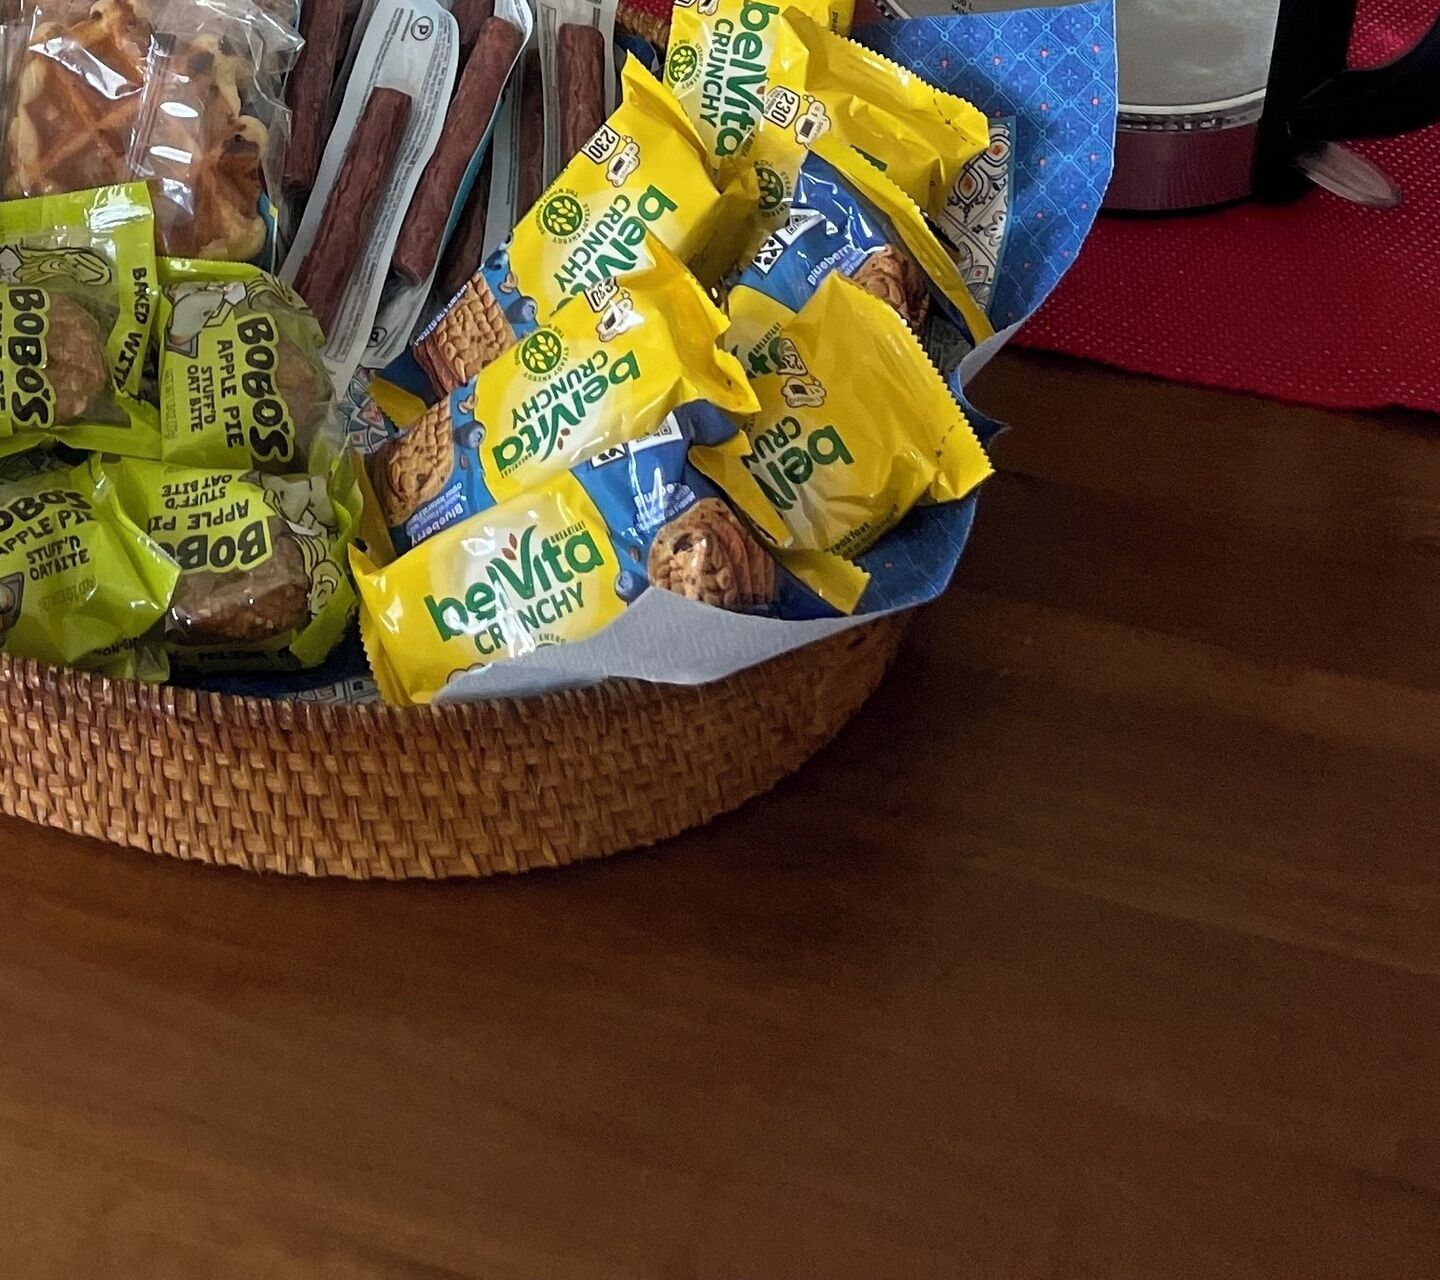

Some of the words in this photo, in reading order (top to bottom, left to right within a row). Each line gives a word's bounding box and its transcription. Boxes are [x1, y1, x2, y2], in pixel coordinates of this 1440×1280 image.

[699, 18, 734, 130] CRUNCHY
[715, 0, 781, 157] belVita
[770, 91, 796, 125] 230
[588, 128, 616, 159] 230
[553, 194, 631, 293] CRUNCHY
[132, 267, 151, 325] BAKED
[9, 288, 51, 425] BOBO'S
[187, 365, 201, 394] OAT
[217, 340, 238, 399] APPLE
[201, 366, 217, 425] STUFF'D
[237, 316, 290, 458] BOBO'S
[492, 350, 642, 472] belVita
[511, 349, 609, 430] CRUNCHY
[189, 398, 204, 433] BITE
[223, 406, 245, 449] PIE
[161, 479, 199, 498] BITE
[164, 486, 227, 510] STUFF'D
[202, 473, 233, 490] OAT
[187, 498, 250, 530] APPLE
[410, 503, 464, 548] Blueberry
[26, 535, 82, 565] STUFF'D
[29, 559, 58, 581] OAT
[55, 549, 90, 574] BITE
[424, 525, 606, 642] belVita
[474, 582, 585, 655] CRNCHY
